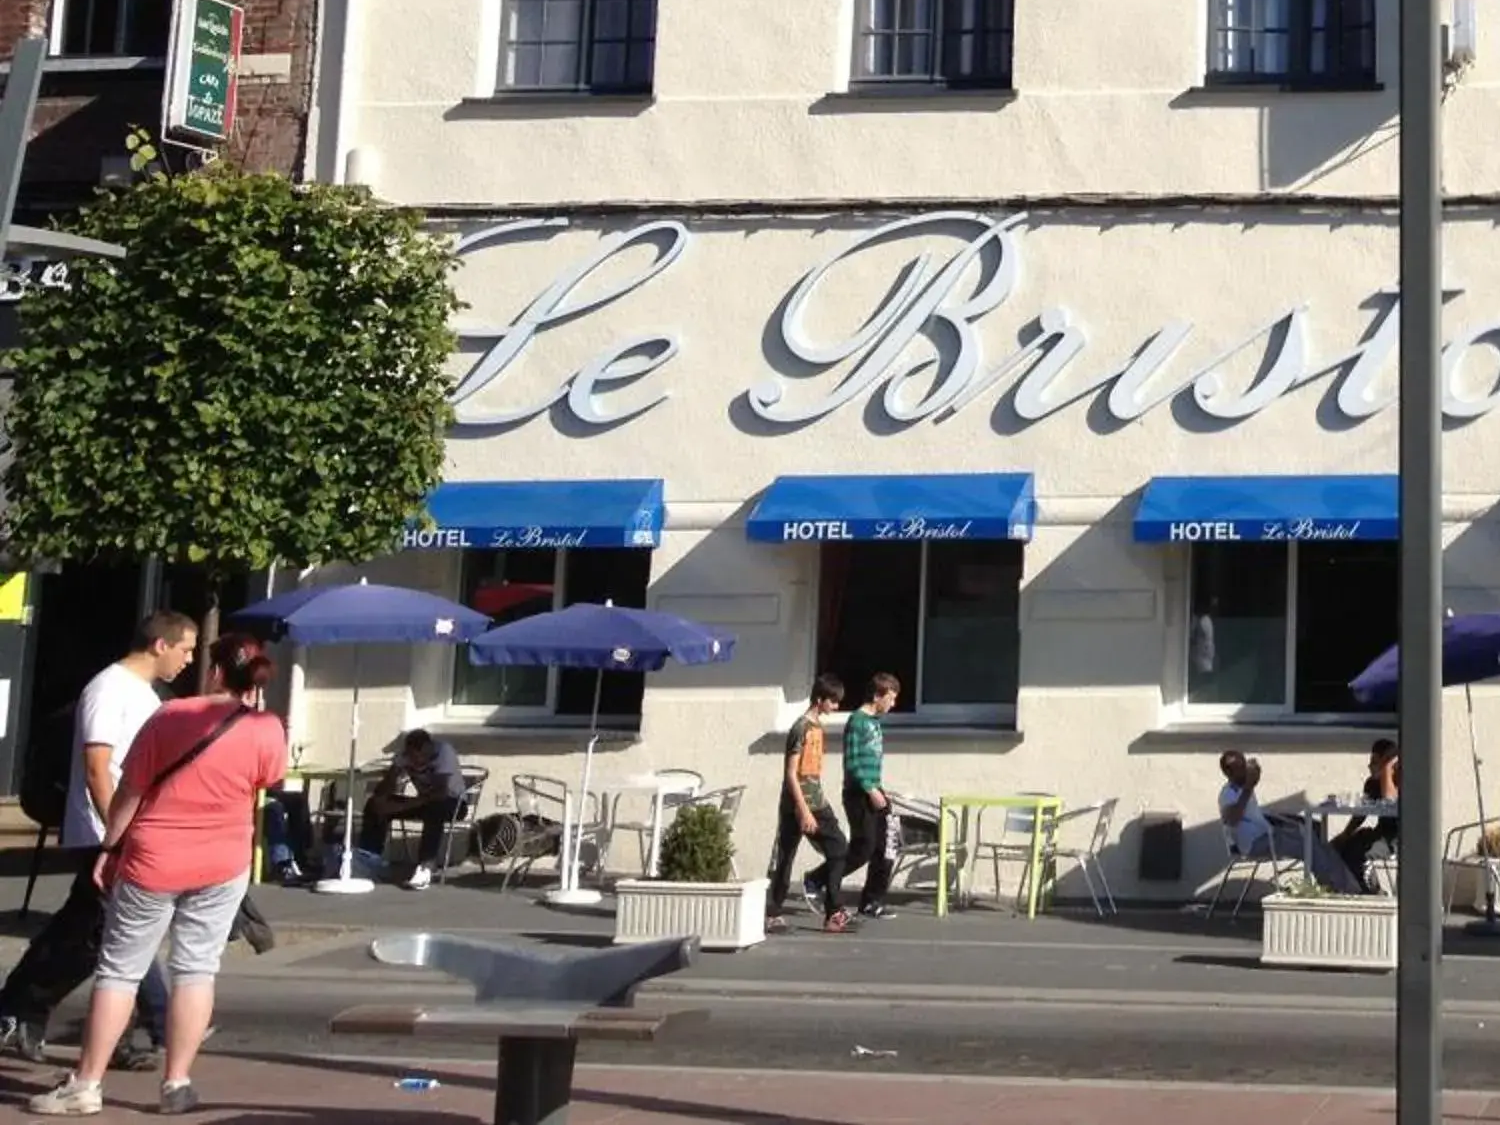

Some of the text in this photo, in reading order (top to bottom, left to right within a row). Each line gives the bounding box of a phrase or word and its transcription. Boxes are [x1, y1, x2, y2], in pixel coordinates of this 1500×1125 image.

[446, 218, 689, 424] Le
[403, 526, 588, 547] HOTEL Le Bristol
[783, 515, 972, 539] HOTEL Le Bristol
[1170, 516, 1360, 540] HOTEL Le Bristol
